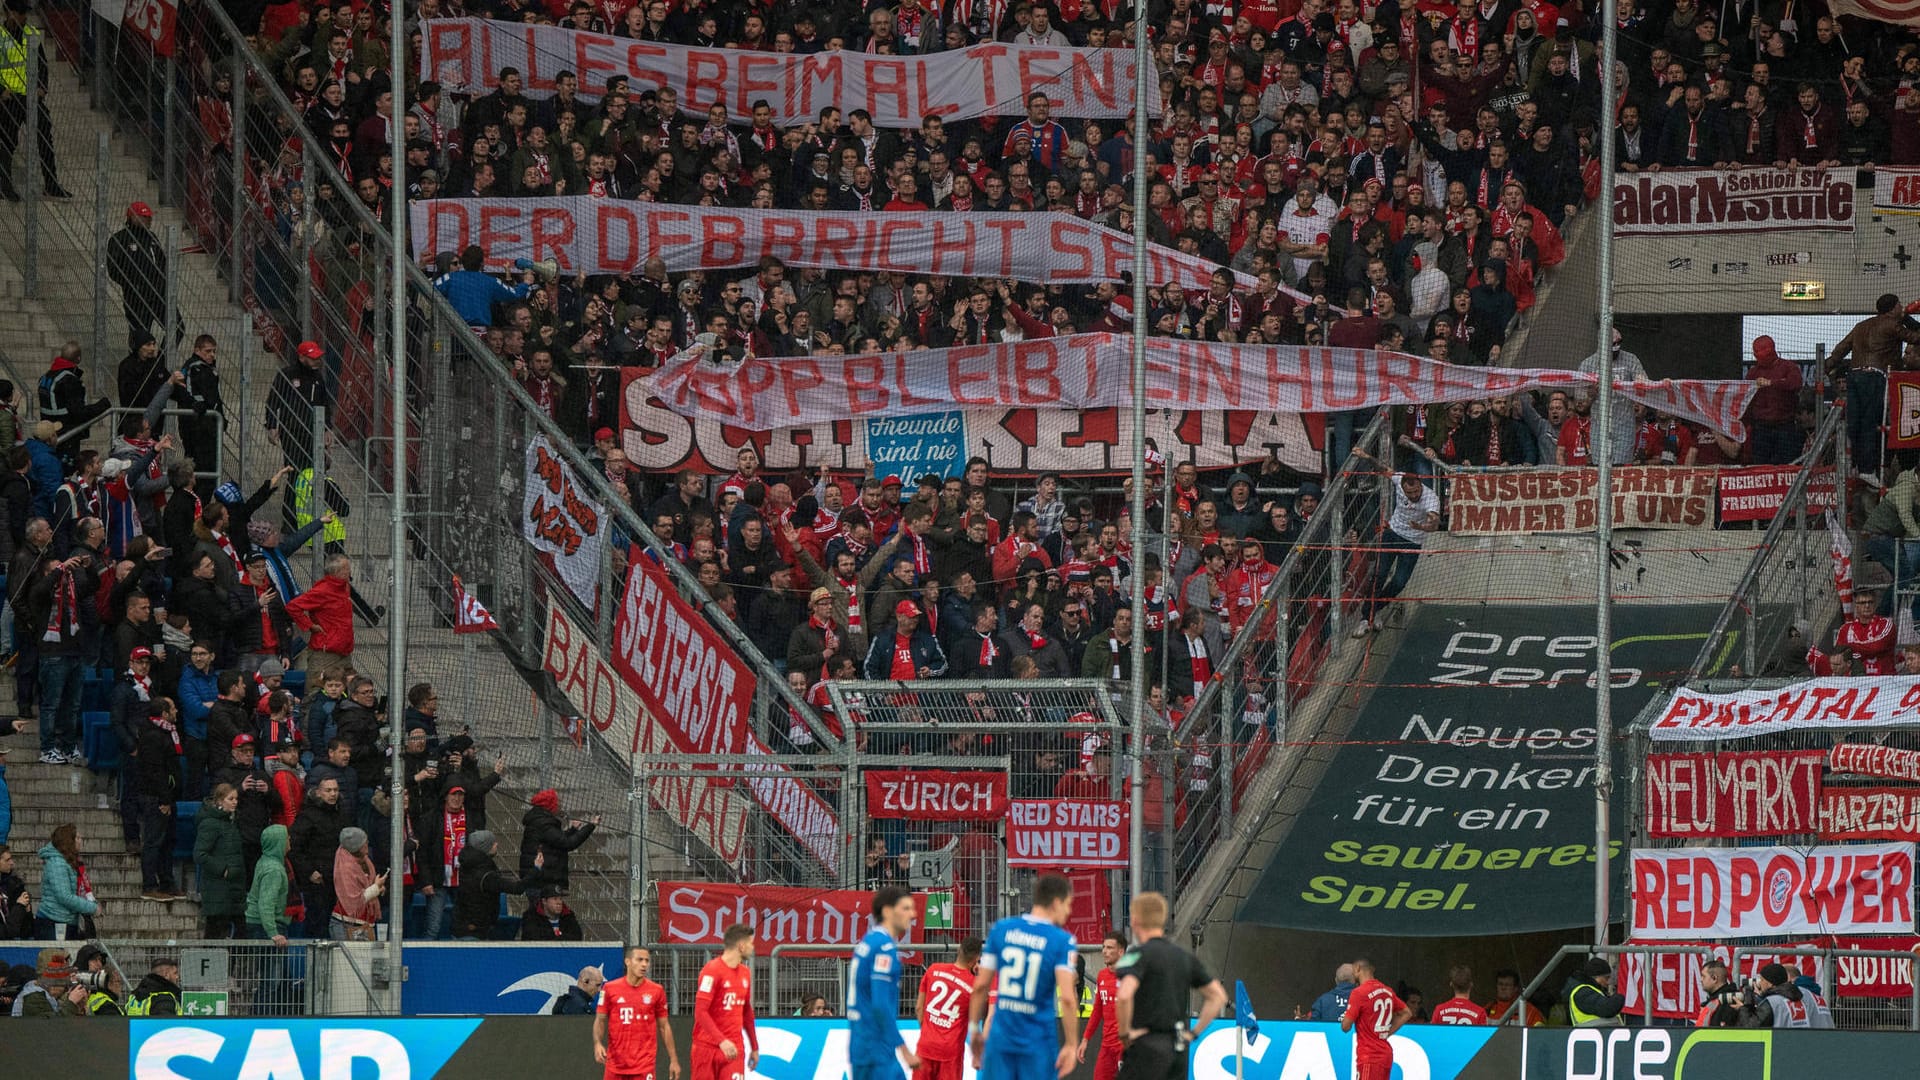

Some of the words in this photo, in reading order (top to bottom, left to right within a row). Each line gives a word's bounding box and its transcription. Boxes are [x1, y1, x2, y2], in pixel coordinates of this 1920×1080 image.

[430, 22, 669, 105] ALLES
[685, 50, 844, 119] BEIM
[1728, 172, 1797, 192] Sektion
[427, 202, 577, 271] DER
[597, 205, 747, 271] DFB
[761, 217, 1027, 277] BRICHT
[843, 332, 1112, 415] BLEIBT
[1129, 339, 1241, 407] EIN
[871, 417, 961, 437] Freunde
[874, 438, 922, 463] sind
[926, 438, 957, 460] nie
[1721, 473, 1774, 491] FREIHEIT
[1452, 503, 1567, 532] IMMER
[1574, 498, 1626, 530] BI
[1637, 495, 1707, 527] UNS
[1441, 631, 1598, 660] pre
[544, 606, 616, 732] BAD
[1429, 662, 1642, 690] zero
[1400, 713, 1597, 750] Neues
[1830, 744, 1882, 773] LETZTE
[881, 775, 993, 812] ZÜRICH
[1647, 756, 1822, 833] NEUMARKT
[1012, 804, 1050, 826] RED
[1055, 802, 1121, 828] STARS
[1352, 794, 1444, 828] für
[1458, 802, 1551, 831] ein
[1819, 792, 1920, 834] HARZBU
[1015, 831, 1121, 858] UNITED
[1323, 839, 1623, 872] sauberes
[922, 860, 941, 877] G1
[1301, 875, 1477, 913] Spiel.
[1634, 858, 1720, 929] RED
[1730, 851, 1912, 928] POWER
[200, 958, 210, 976] F
[998, 946, 1043, 1000] 21
[926, 980, 962, 1019] 24
[1373, 997, 1393, 1033] 22
[134, 1026, 411, 1080] SAP
[1566, 1028, 1672, 1080] pre
